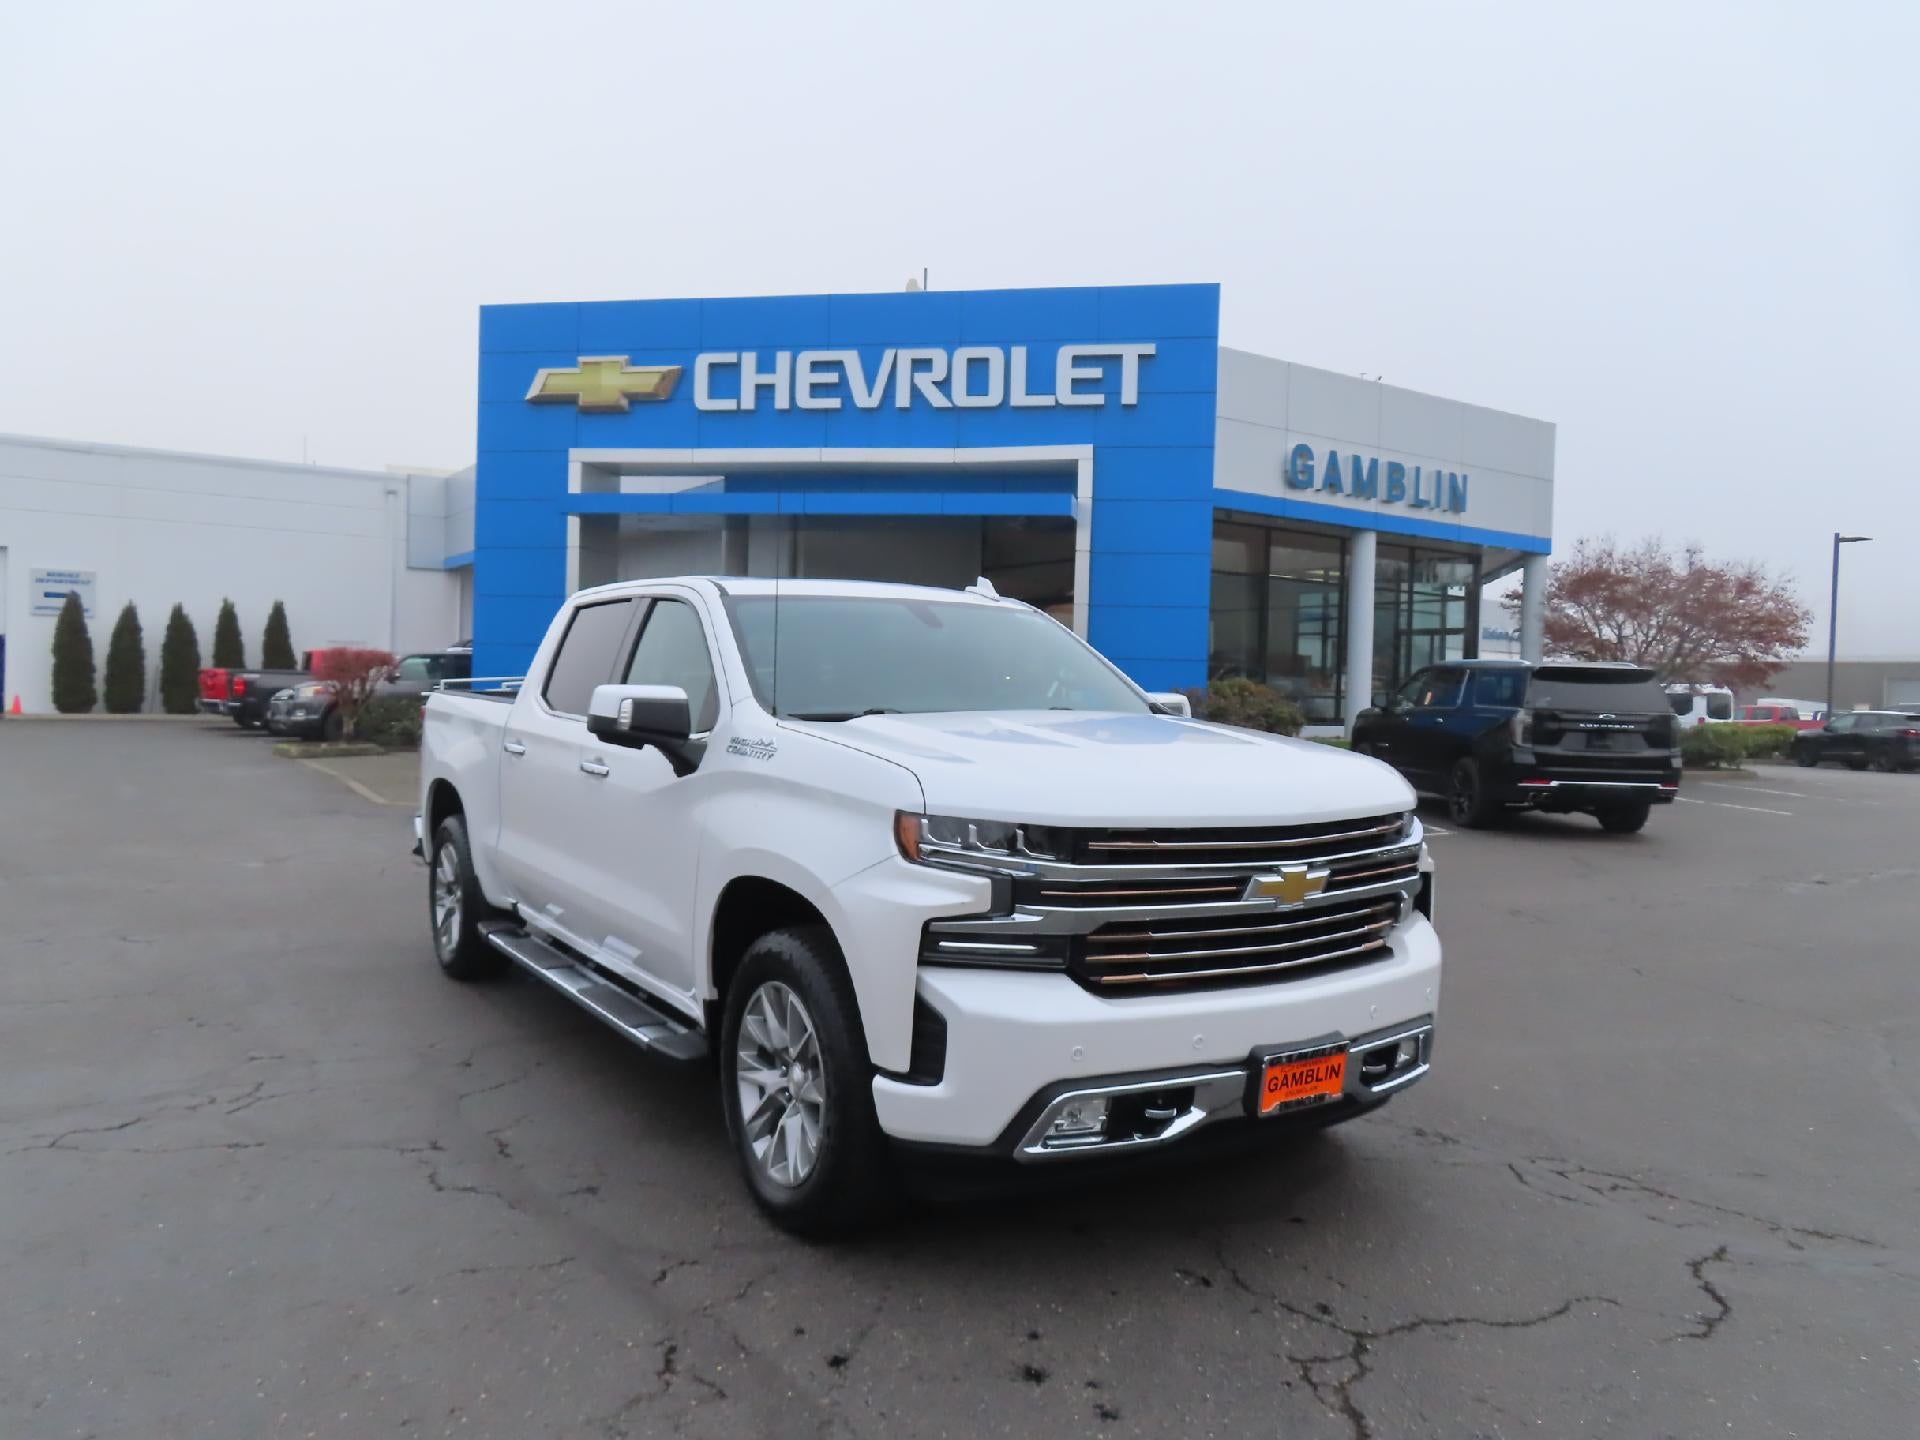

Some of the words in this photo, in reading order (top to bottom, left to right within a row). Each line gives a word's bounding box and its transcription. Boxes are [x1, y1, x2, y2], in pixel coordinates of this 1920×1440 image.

[693, 342, 1156, 412] CHEVROLET
[1286, 443, 1468, 514] GAMBLIN
[1267, 1063, 1342, 1093] GAMBLIN
